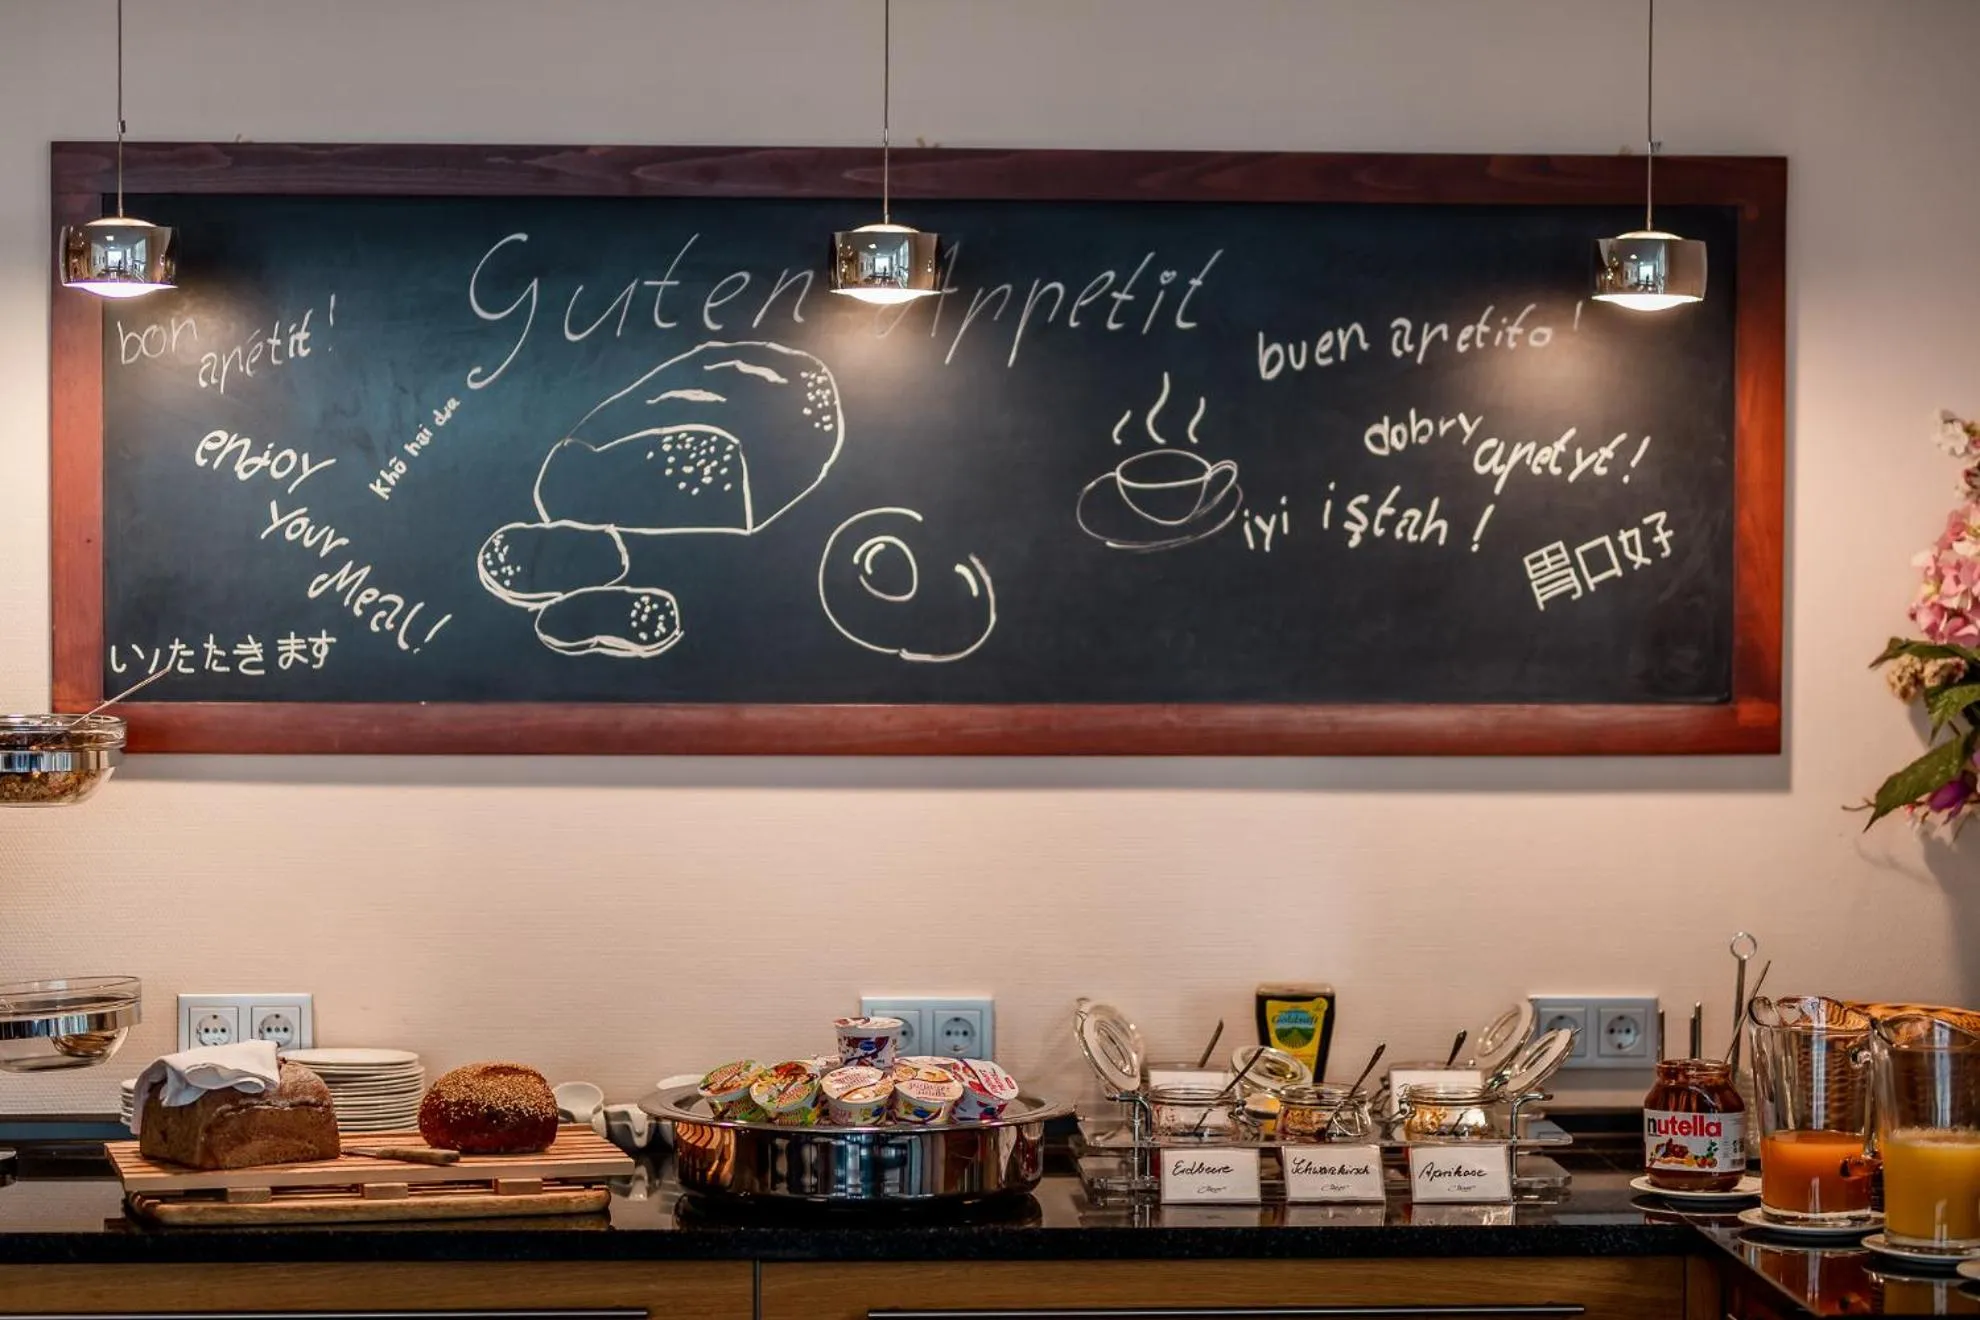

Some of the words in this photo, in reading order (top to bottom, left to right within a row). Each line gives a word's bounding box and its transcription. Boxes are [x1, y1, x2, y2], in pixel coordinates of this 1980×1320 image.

[467, 231, 815, 390] Guten
[117, 318, 198, 365] bon
[1258, 322, 1370, 381] buen
[1364, 408, 1483, 456] dobry
[194, 428, 336, 494] enjoy
[1243, 496, 1289, 552] iyi
[1647, 1115, 1722, 1137] nutella
[1418, 1162, 1488, 1182] Aprikose
